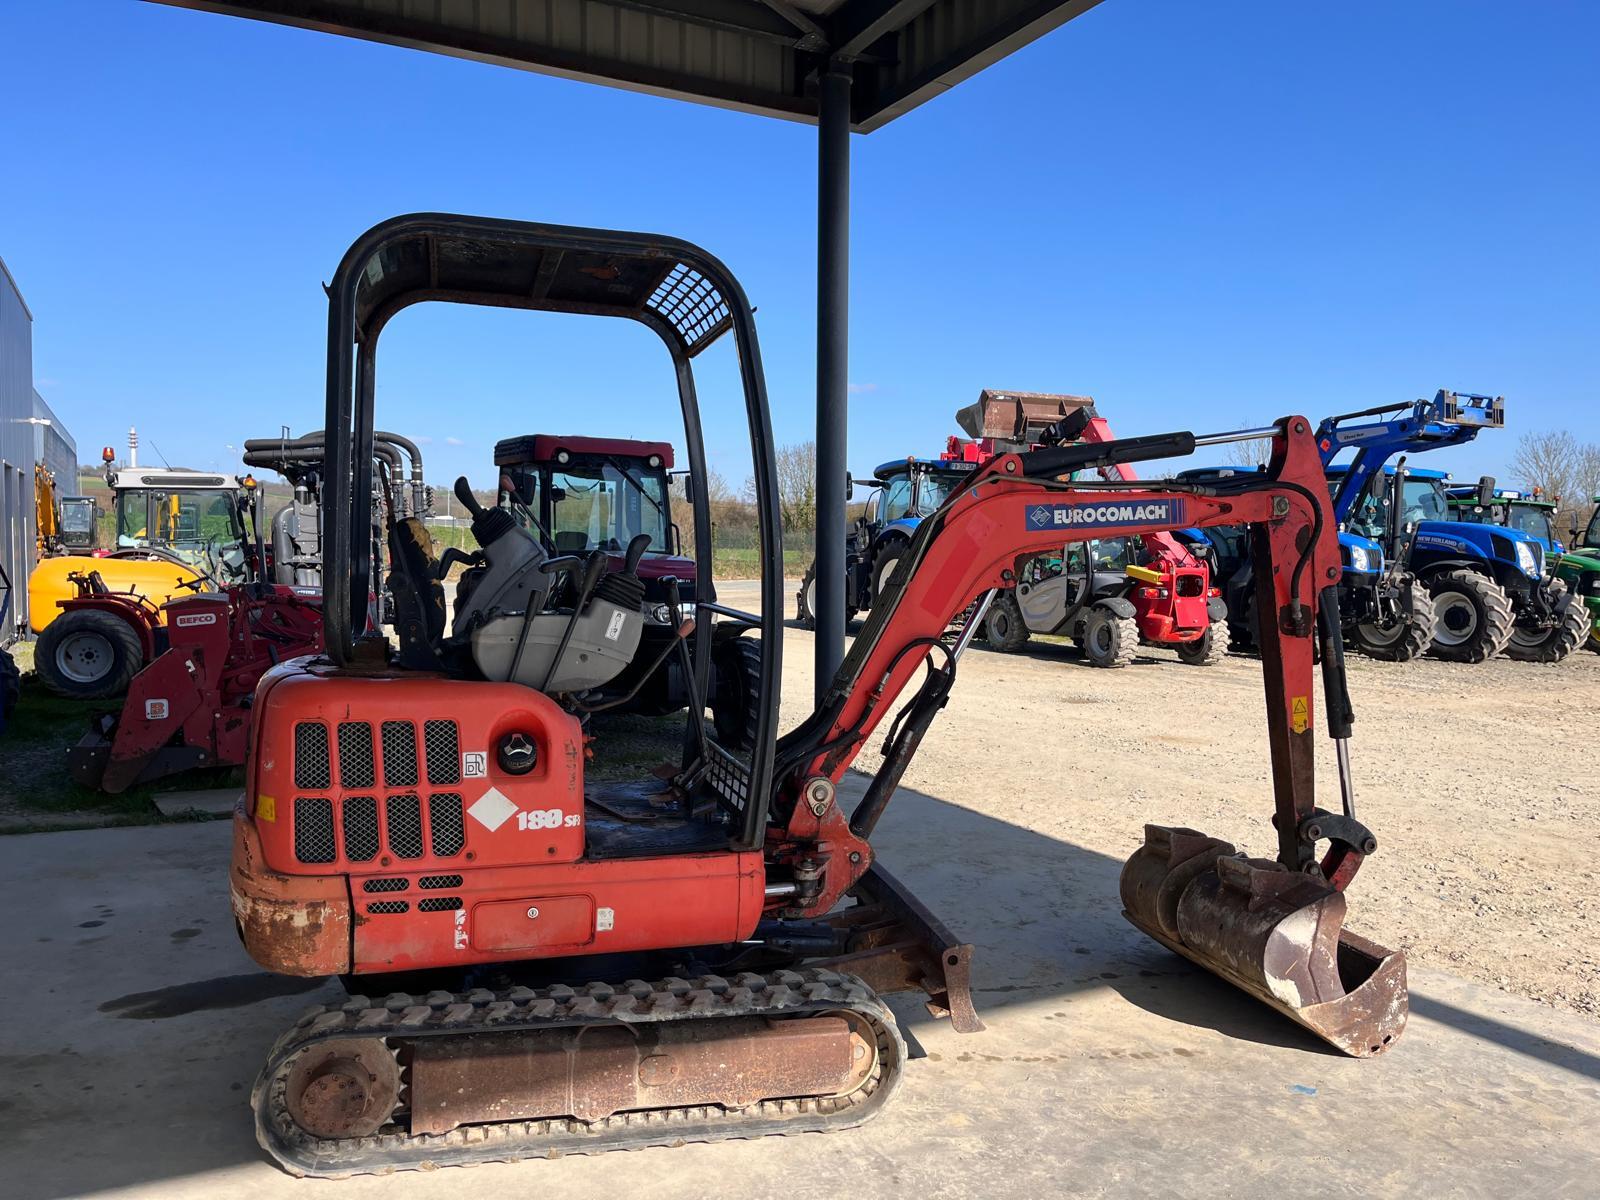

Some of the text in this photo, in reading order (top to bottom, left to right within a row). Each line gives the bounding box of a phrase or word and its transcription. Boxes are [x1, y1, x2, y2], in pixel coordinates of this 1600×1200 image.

[1053, 505, 1167, 524] EUROCOMACH
[1431, 537, 1457, 546] HOLLAND
[179, 615, 213, 625] BEFCO
[467, 764, 475, 773] D
[516, 809, 562, 831] 180
